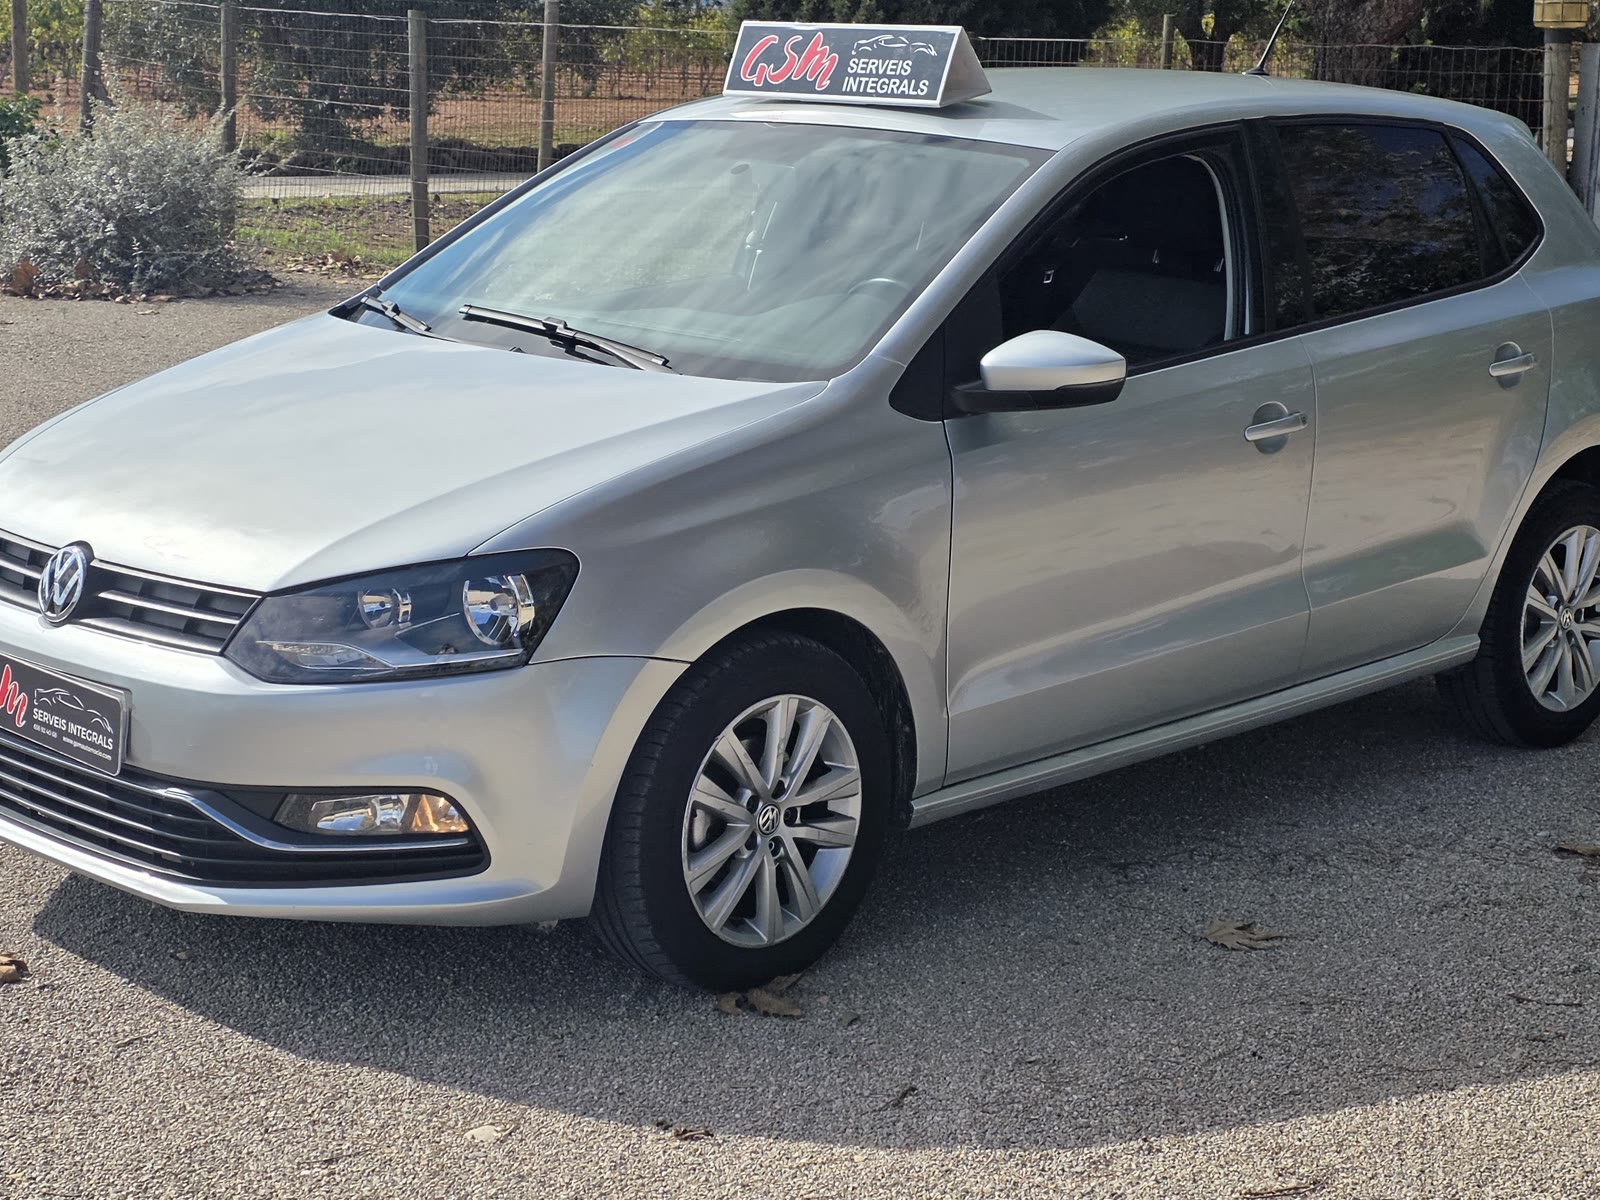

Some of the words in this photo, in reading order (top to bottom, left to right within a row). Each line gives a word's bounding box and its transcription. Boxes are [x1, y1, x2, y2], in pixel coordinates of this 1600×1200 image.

[847, 57, 912, 76] SERVEIS
[842, 76, 929, 96] INTEGRALS
[33, 707, 67, 731] SERVEIS
[68, 721, 113, 751] INTEGRALS
